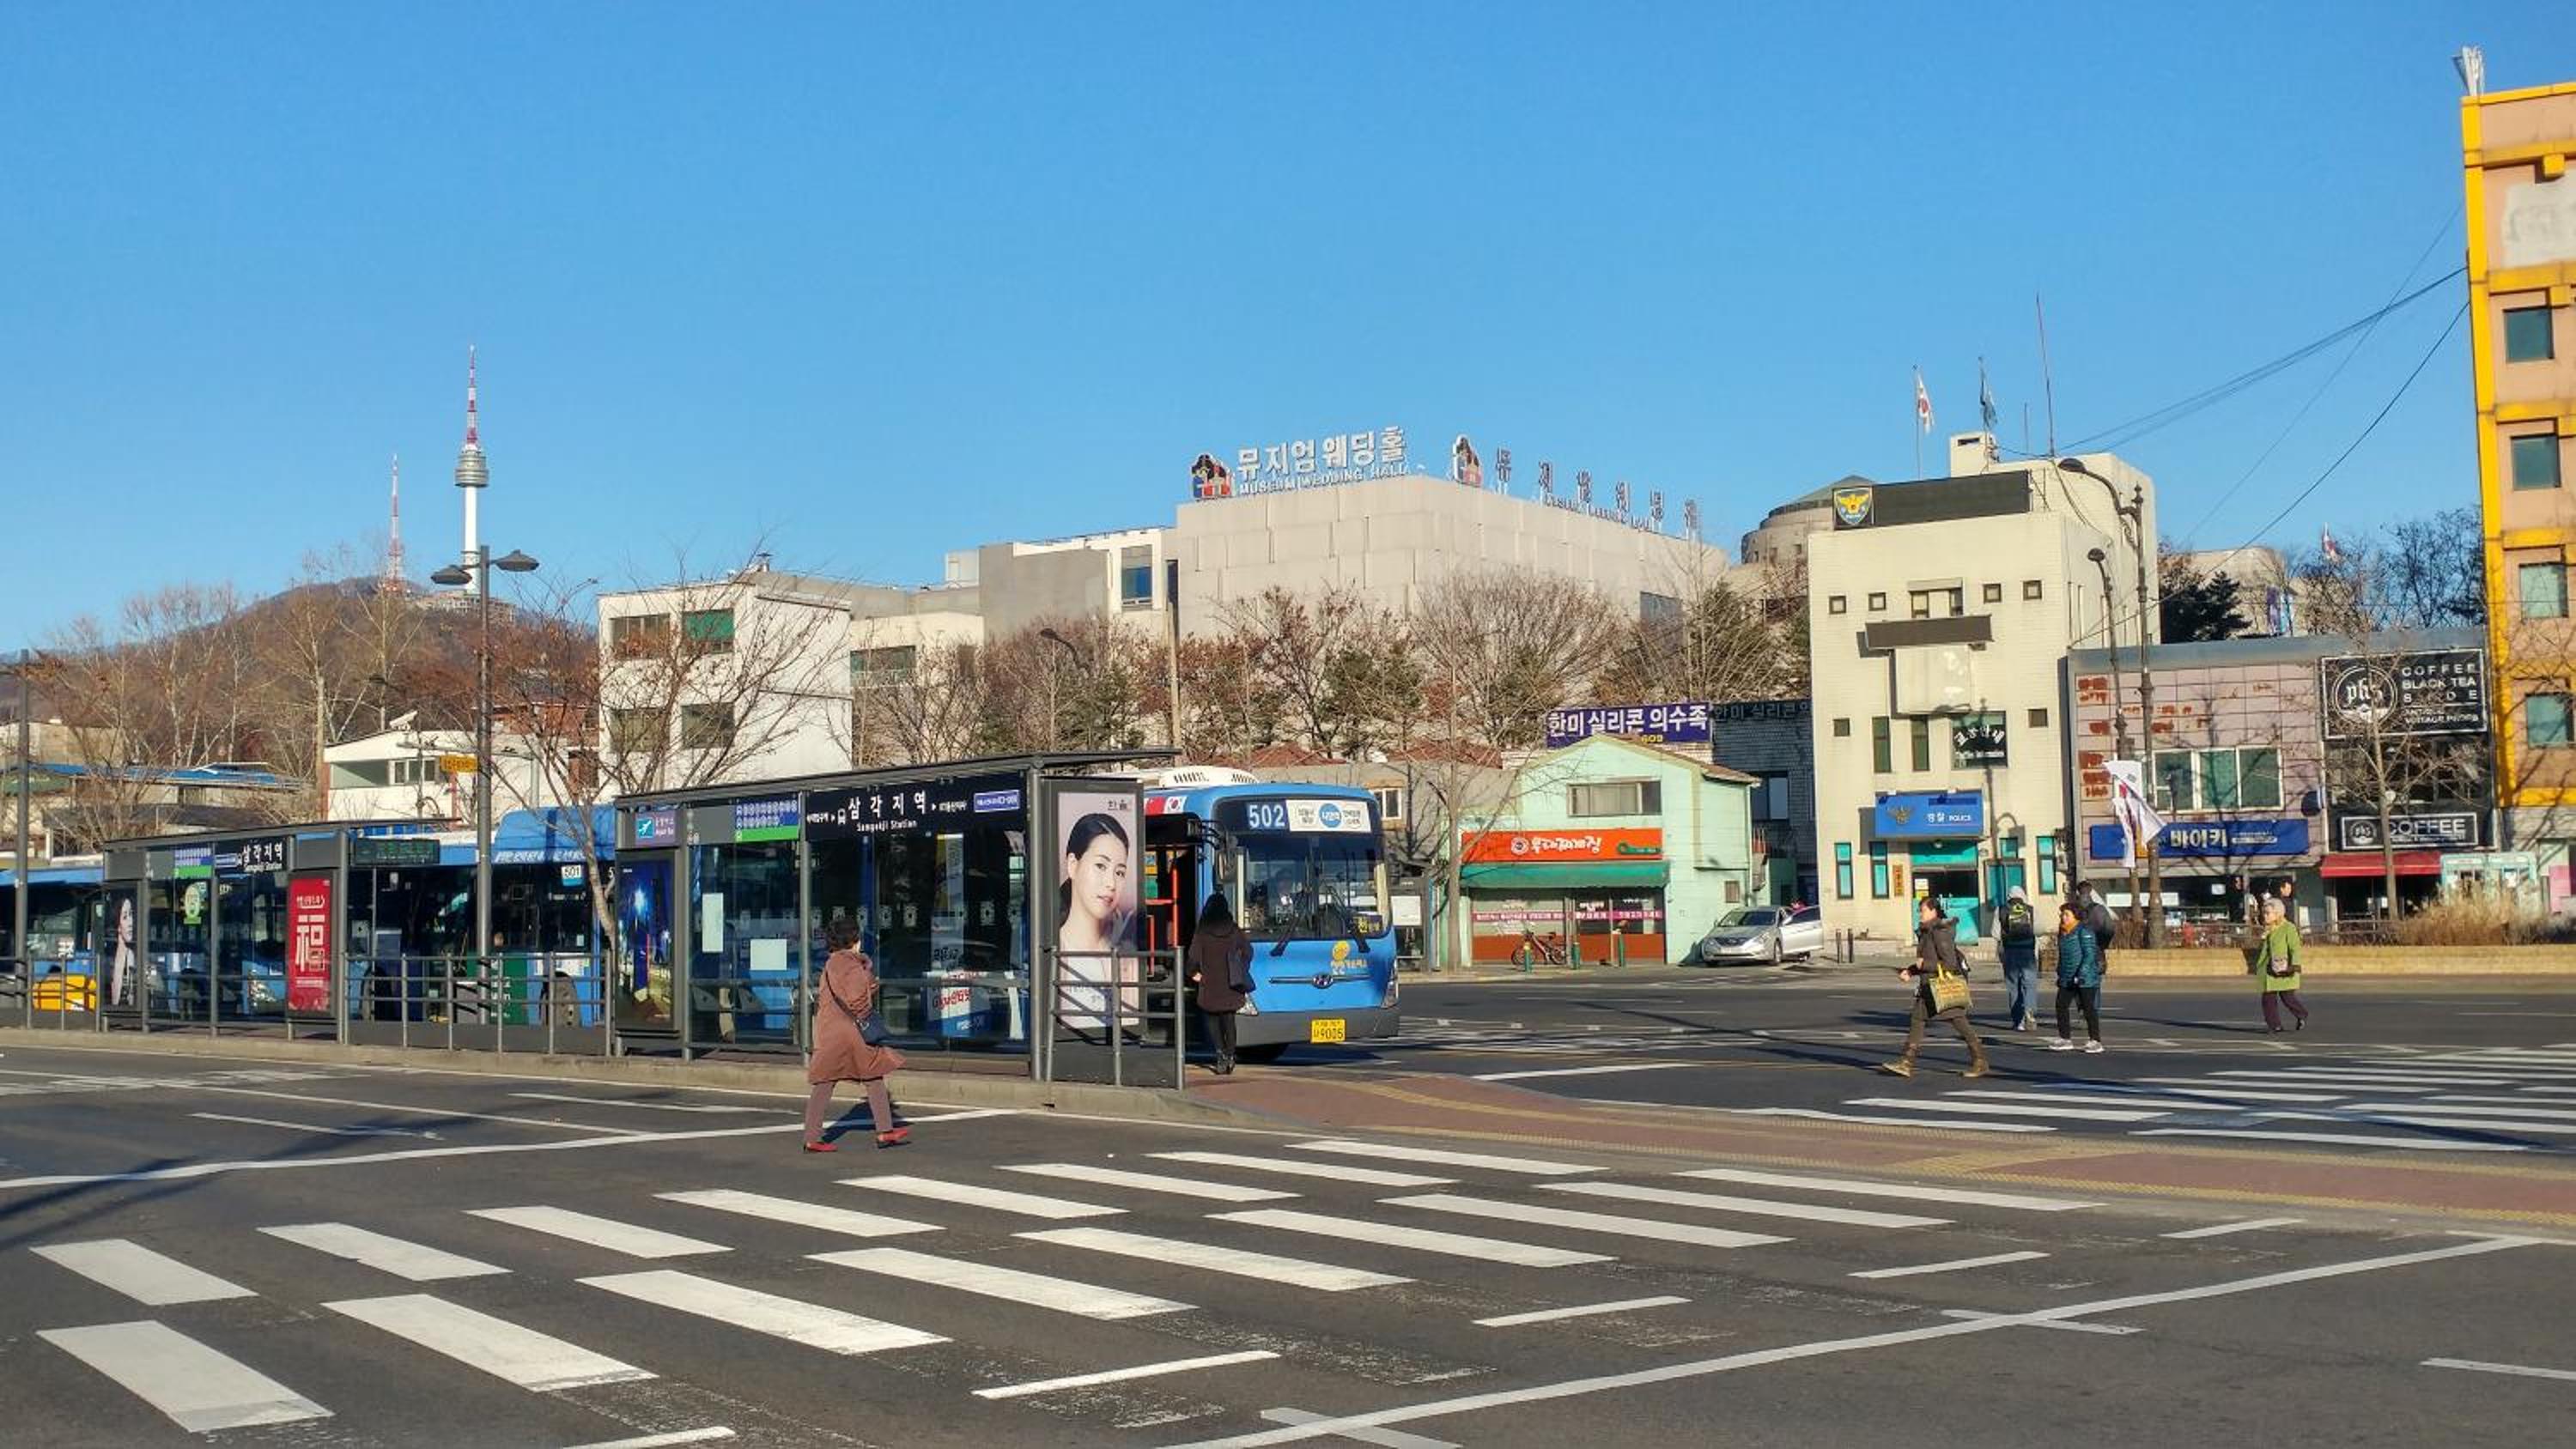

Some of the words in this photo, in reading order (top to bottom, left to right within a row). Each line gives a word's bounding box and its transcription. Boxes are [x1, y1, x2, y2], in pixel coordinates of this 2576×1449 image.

[1239, 476, 1297, 496] MUSEUM
[1298, 469, 1364, 490] WEDDING
[1370, 465, 1408, 481] HALL
[2402, 663, 2476, 676] COFFEE
[2402, 678, 2447, 690] BLACK
[2450, 676, 2477, 688] TEA
[1548, 711, 1584, 737] 한미
[1588, 707, 1644, 735] 실리콘
[1649, 705, 1708, 731] 의수족
[848, 790, 926, 820] 삼각지역
[1249, 804, 1285, 828] 502
